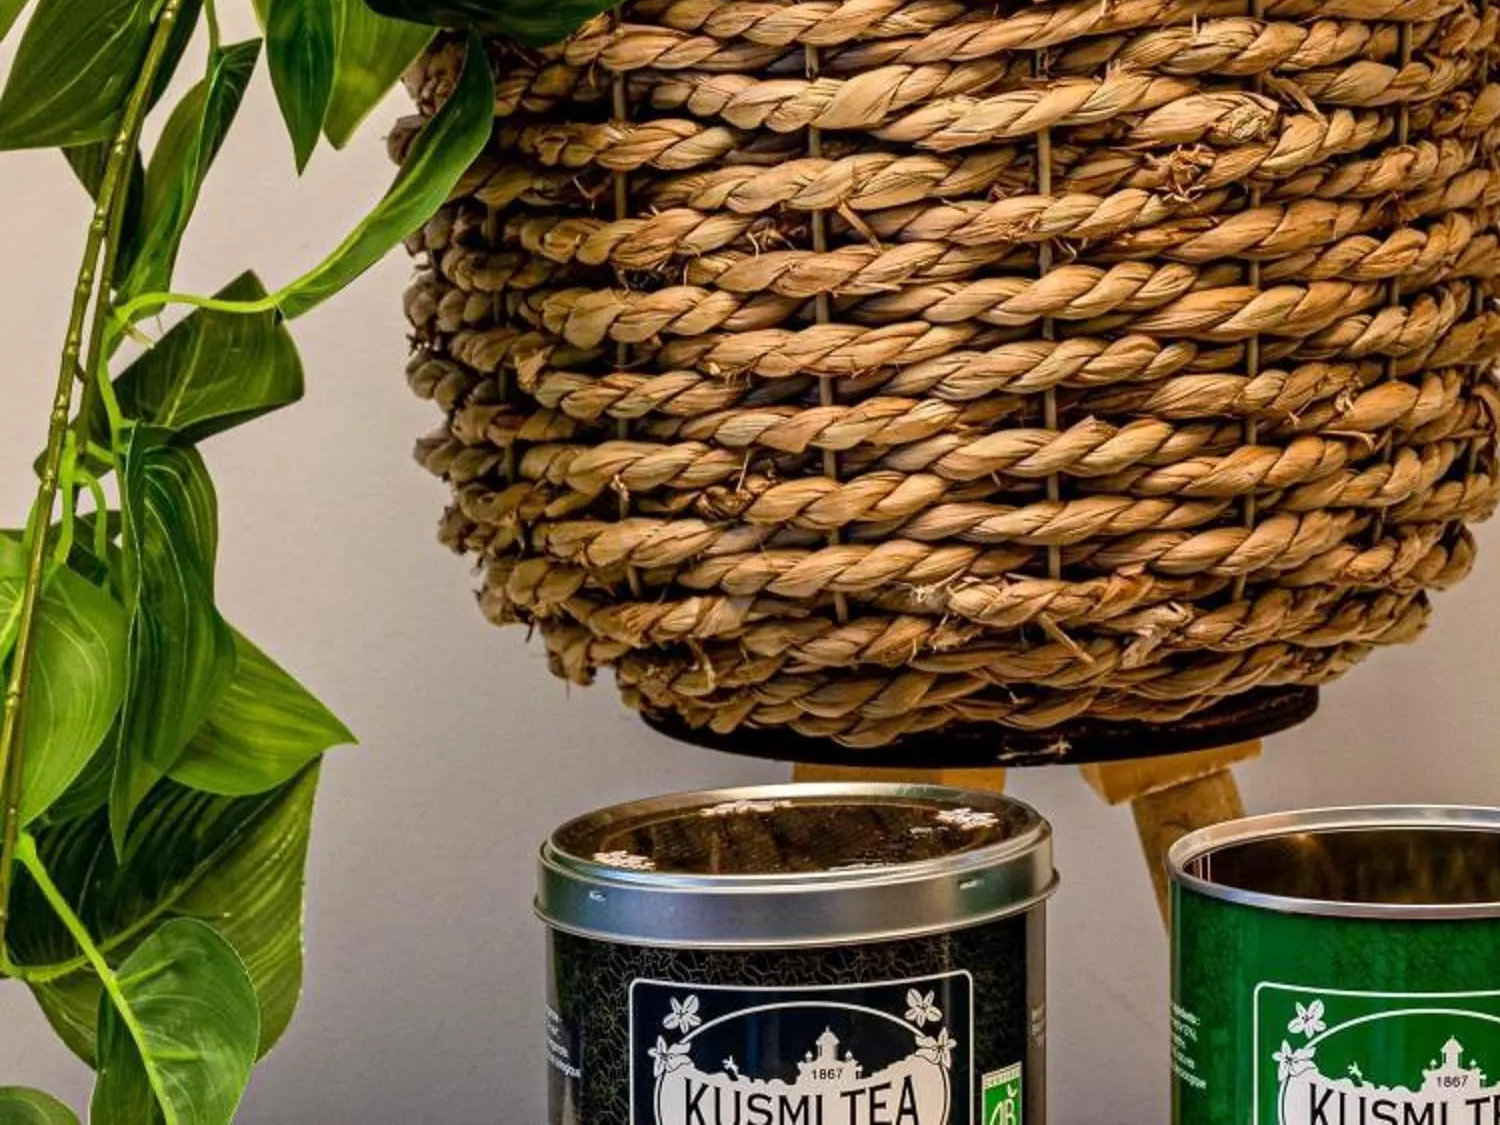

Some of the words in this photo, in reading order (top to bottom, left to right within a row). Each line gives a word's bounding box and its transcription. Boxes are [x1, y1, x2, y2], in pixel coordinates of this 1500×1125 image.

[812, 1068, 843, 1081] 1867
[1436, 1076, 1468, 1088] 1867
[684, 1076, 823, 1125] KUSMI
[840, 1075, 919, 1125] TEA
